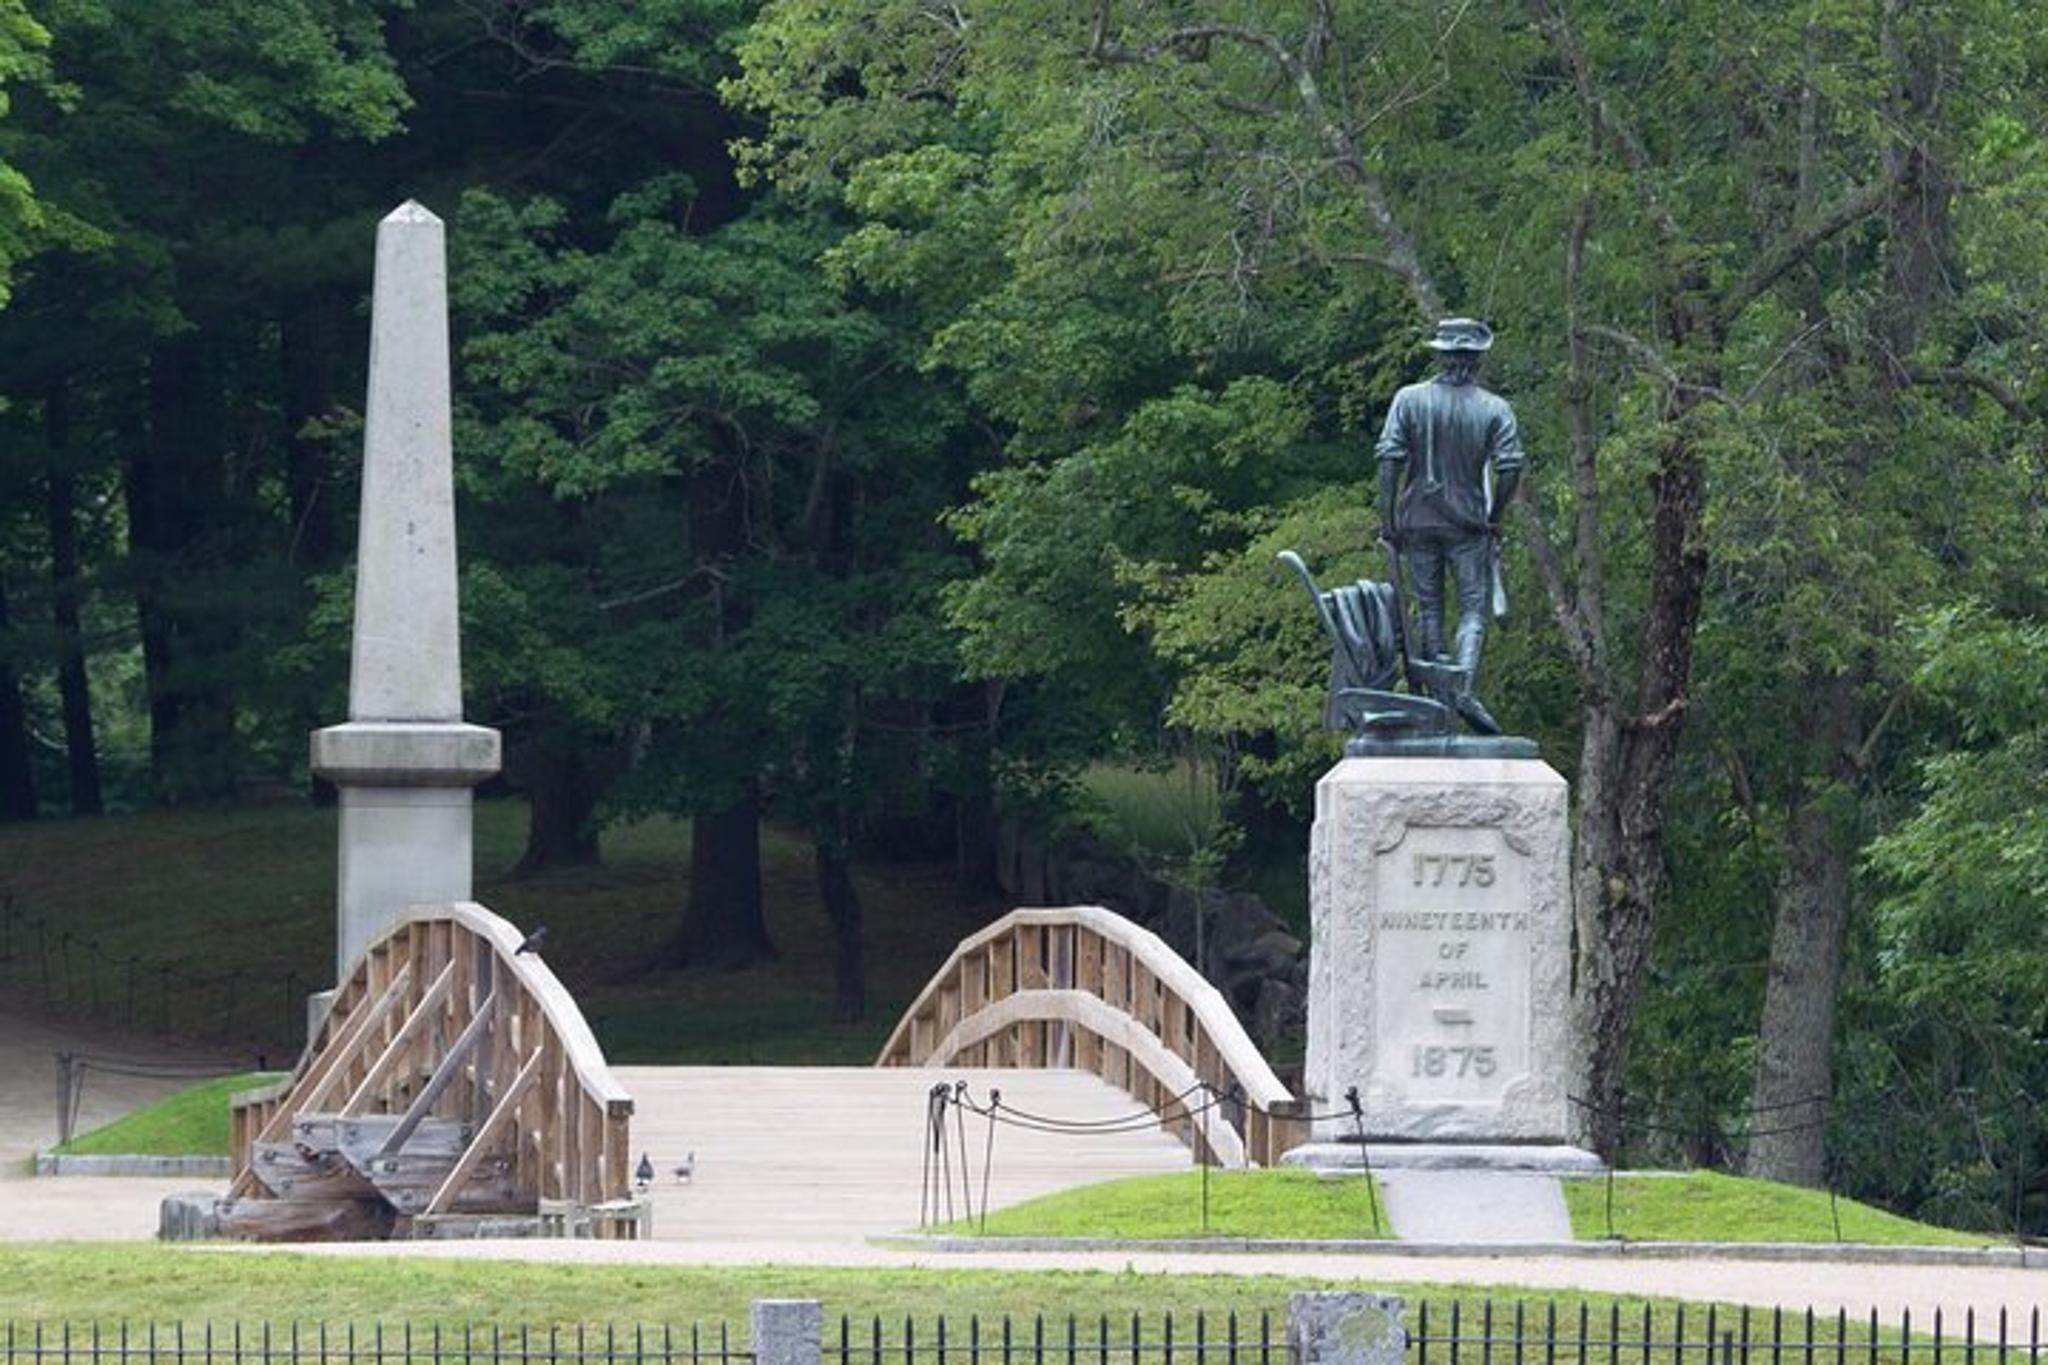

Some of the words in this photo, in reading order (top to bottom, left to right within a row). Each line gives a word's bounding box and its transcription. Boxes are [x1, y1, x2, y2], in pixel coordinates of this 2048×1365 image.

[1412, 853, 1496, 888] 1775
[1380, 911, 1529, 931] NINETEENTH
[1439, 942, 1469, 960] OF
[1419, 971, 1490, 990] APRIL
[1411, 1045, 1497, 1078] 1875
